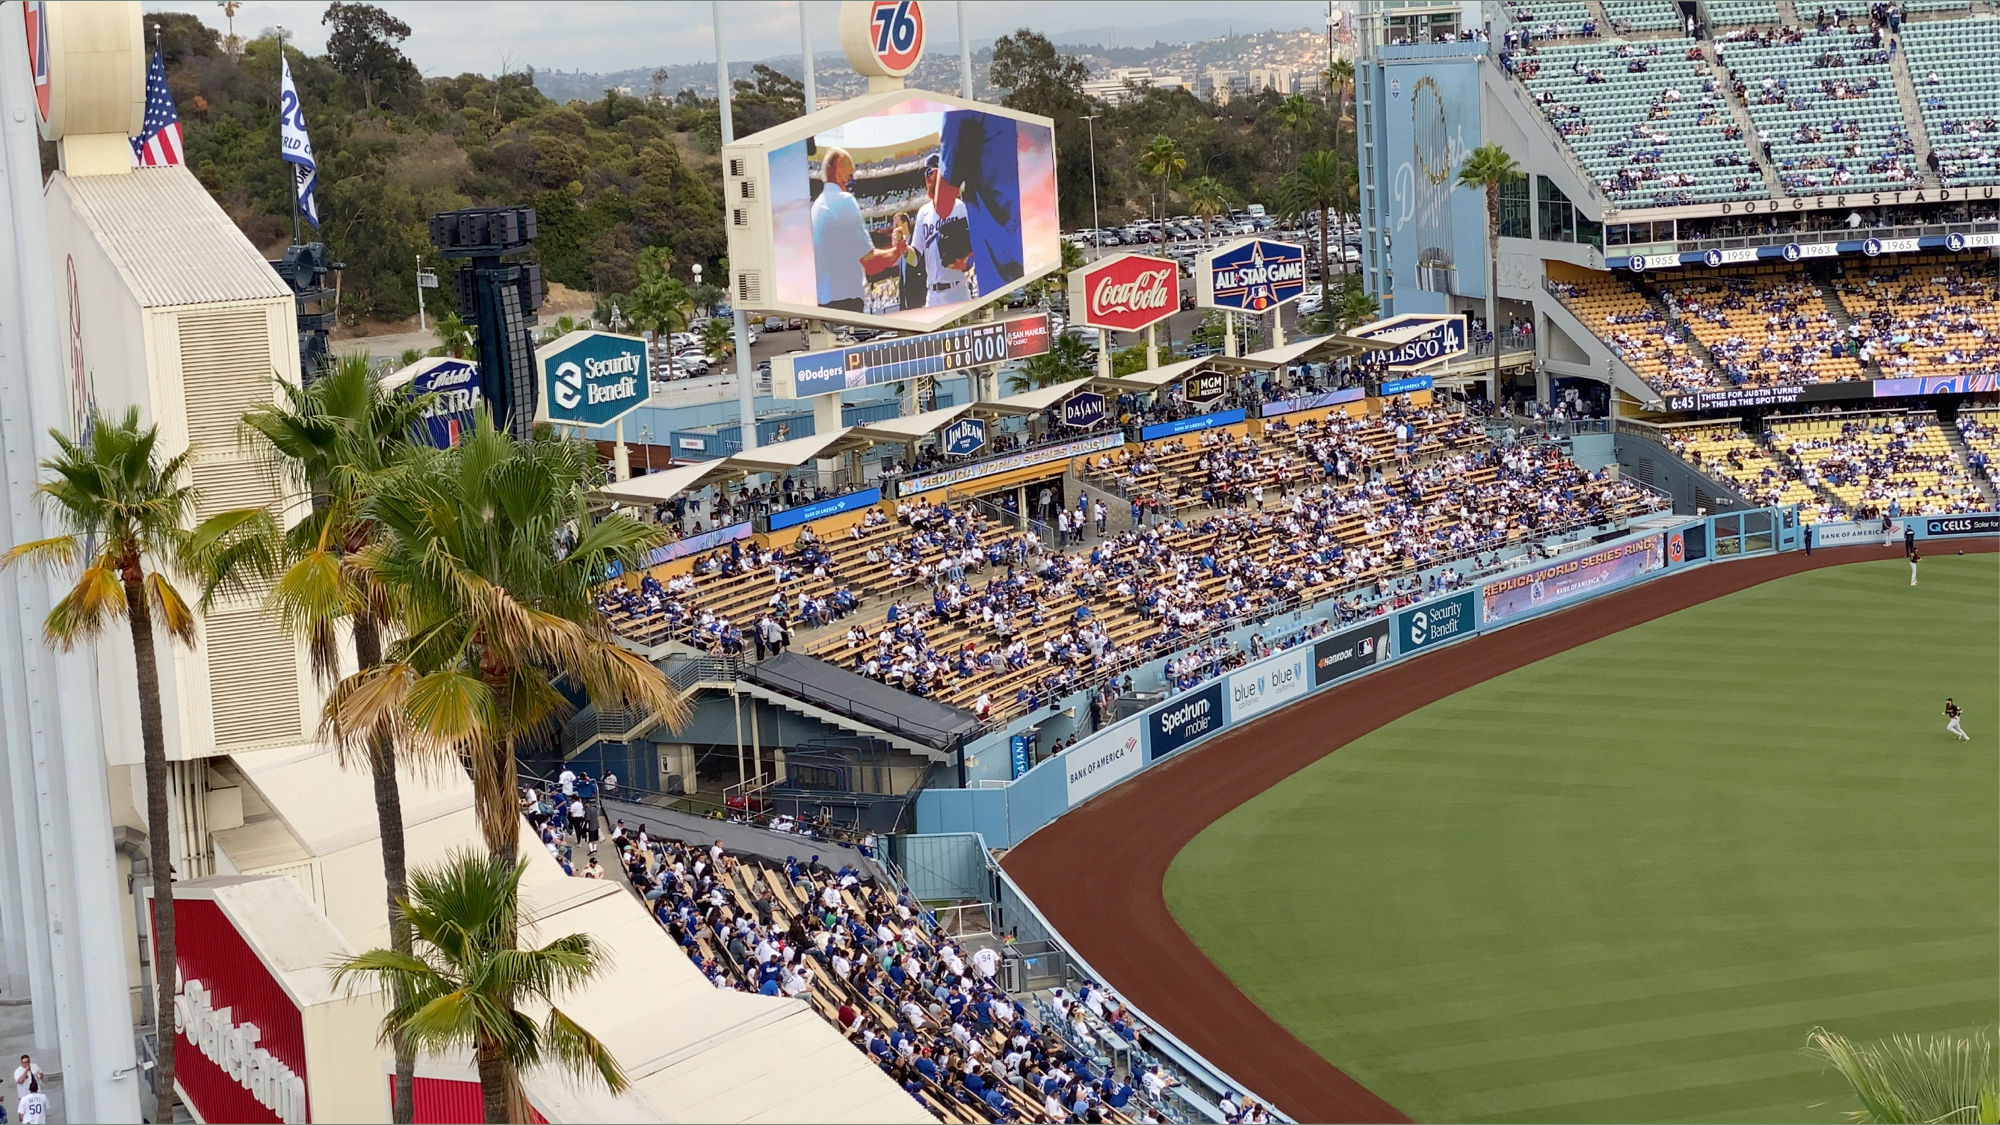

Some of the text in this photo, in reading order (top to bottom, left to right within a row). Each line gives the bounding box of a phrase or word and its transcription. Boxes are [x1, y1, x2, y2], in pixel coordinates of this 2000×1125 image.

[872, 1, 917, 55] 76
[281, 135, 301, 150] RLD
[1722, 187, 1993, 214] DODGER STADIU
[1887, 240, 1912, 250] 1965
[1970, 236, 1994, 246] 1981
[1727, 250, 1750, 260] 1959
[1806, 245, 1830, 255] 1963
[1633, 256, 1674, 269] B 1955
[1268, 262, 1302, 282] GAME
[1012, 327, 1047, 339] SAN MANUEL
[946, 339, 950, 352] 0
[954, 338, 960, 350] 0
[964, 336, 970, 348] 0
[974, 334, 1005, 361] 0 0 0
[946, 355, 952, 368] 0
[956, 354, 961, 366] 0
[965, 352, 970, 365] 0
[1366, 340, 1439, 365] JALISCO
[584, 350, 641, 379] Security
[797, 366, 843, 382] @Dodgers
[1200, 376, 1222, 388] MGM
[587, 377, 637, 405] Benefit
[1200, 387, 1222, 396] RESORTS
[1701, 393, 1726, 401] THREE
[1728, 391, 1742, 399] FOR
[1744, 388, 1771, 398] JUSTIN
[1671, 396, 1694, 409] 6:45
[1711, 400, 1729, 408] THIS
[1740, 398, 1754, 406] THE
[1754, 396, 1775, 406] SPOT
[1777, 394, 1797, 404] THAT
[1067, 400, 1103, 420] DASANI
[948, 426, 962, 452] JIM
[962, 421, 984, 443] BEAM
[921, 439, 1100, 488] REPLICA WORLD SERIES RING
[1929, 522, 1942, 532] Q
[1942, 520, 1972, 531] CELLS
[1821, 532, 1840, 540] BANK
[1670, 541, 1682, 555] 76
[1482, 540, 1653, 598] REPLICA WORLD SERIES RING
[1429, 601, 1462, 623] Security
[1430, 619, 1459, 640] Benefit
[1234, 668, 1293, 702] blue blue
[1161, 698, 1208, 735] Spectrum
[1184, 717, 1208, 739] mobile
[1070, 748, 1124, 784] BANK OF AMERICA
[982, 954, 991, 962] 94
[29, 1104, 42, 1115] 50
